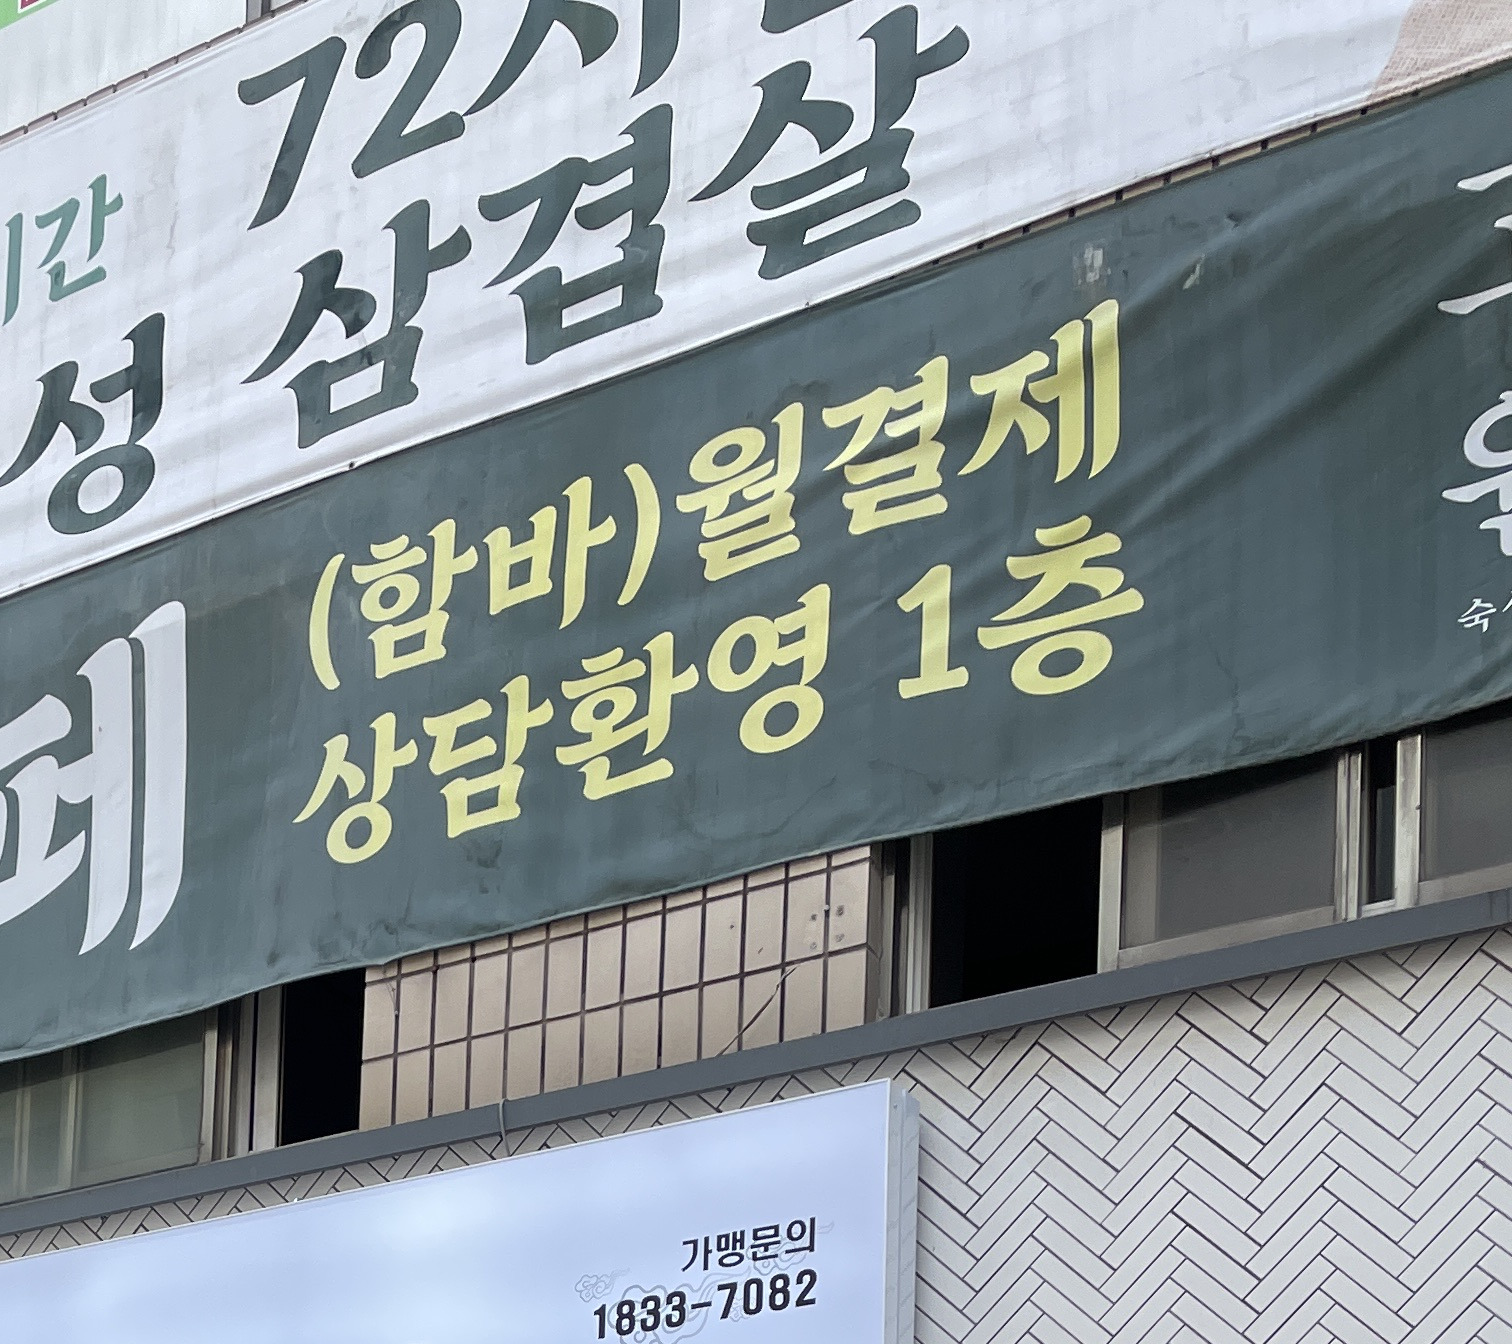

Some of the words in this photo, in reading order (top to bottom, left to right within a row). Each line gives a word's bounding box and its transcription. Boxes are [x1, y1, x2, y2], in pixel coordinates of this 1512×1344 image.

[238, 0, 854, 230] 72시
[241, 4, 970, 448] 삼겹살
[293, 583, 832, 865] 상담환영
[896, 515, 1145, 699] 1층
[1457, 597, 1512, 633] 숙
[593, 1269, 818, 1339] 1833-7082
[681, 1216, 817, 1272] 가맹문의
